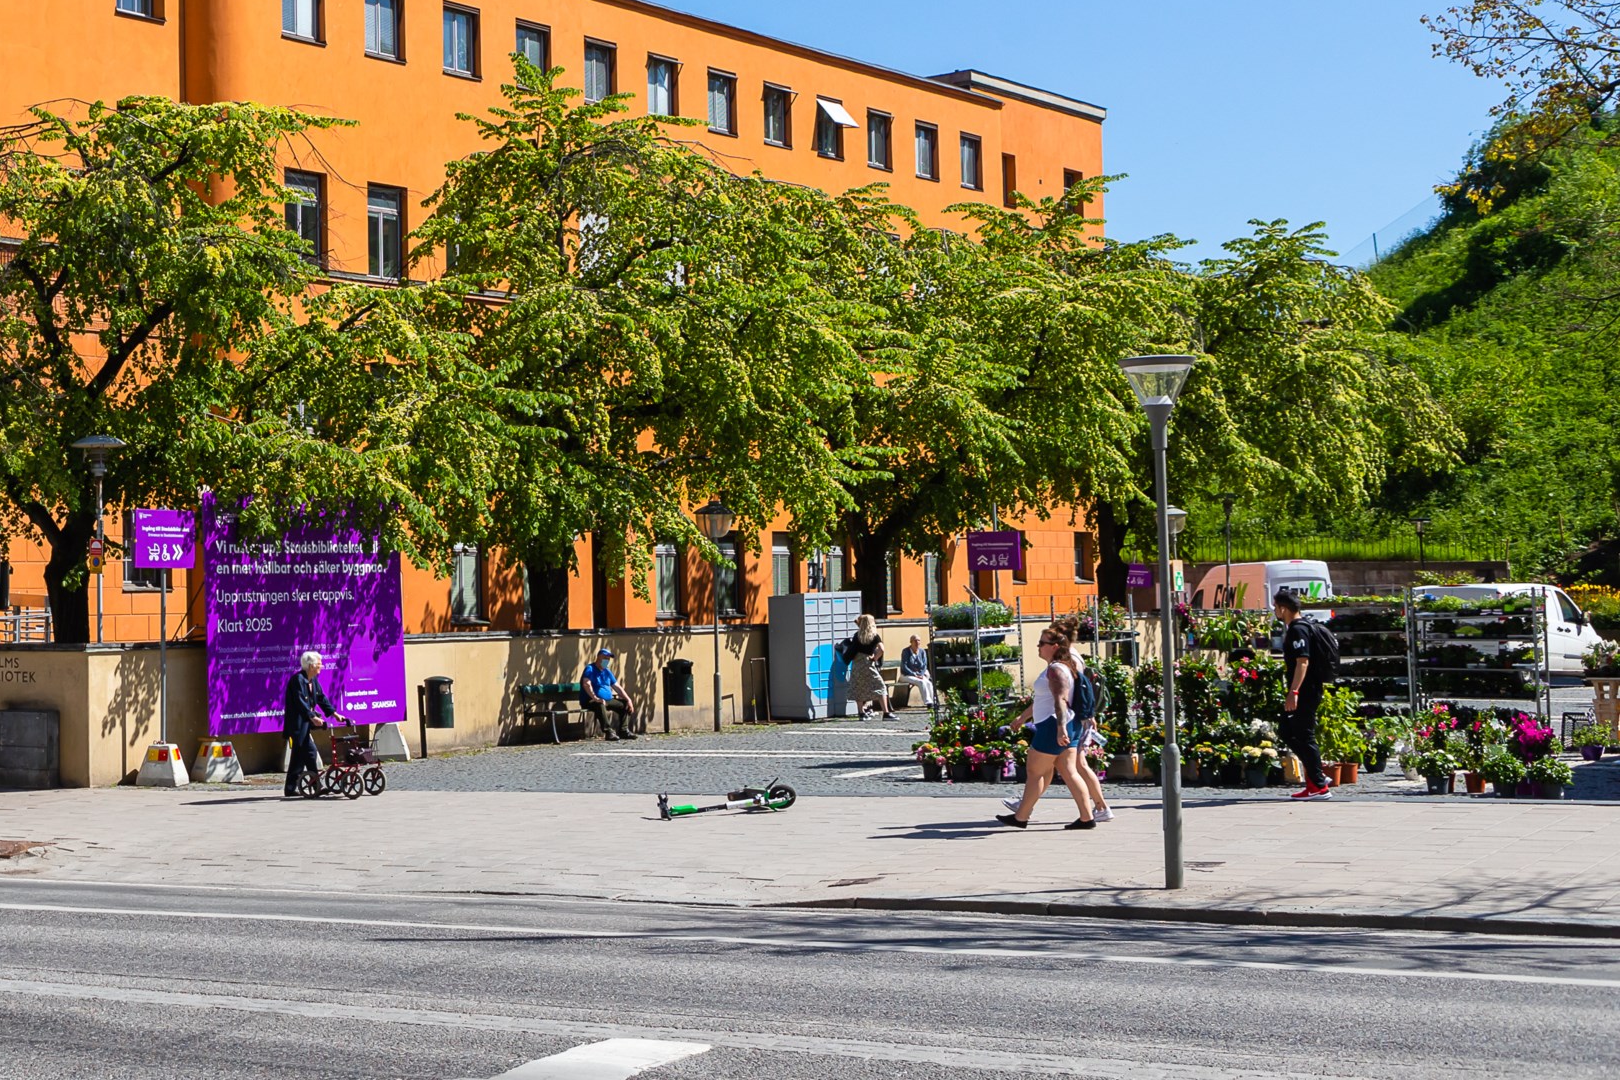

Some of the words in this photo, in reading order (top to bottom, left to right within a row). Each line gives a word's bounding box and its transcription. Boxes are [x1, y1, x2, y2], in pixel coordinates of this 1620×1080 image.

[216, 540, 227, 553] Vi
[216, 564, 229, 574] en
[232, 563, 252, 574] mer
[255, 560, 291, 574] hållbar
[293, 560, 312, 574] och
[314, 560, 340, 574] säker
[216, 589, 289, 605] Upprustningen
[292, 589, 311, 601] sker
[313, 588, 355, 606] etappvis.
[217, 619, 243, 633] Klart
[246, 618, 273, 632] 2025
[353, 701, 368, 710] ebab
[371, 700, 397, 709] SKANSKA
